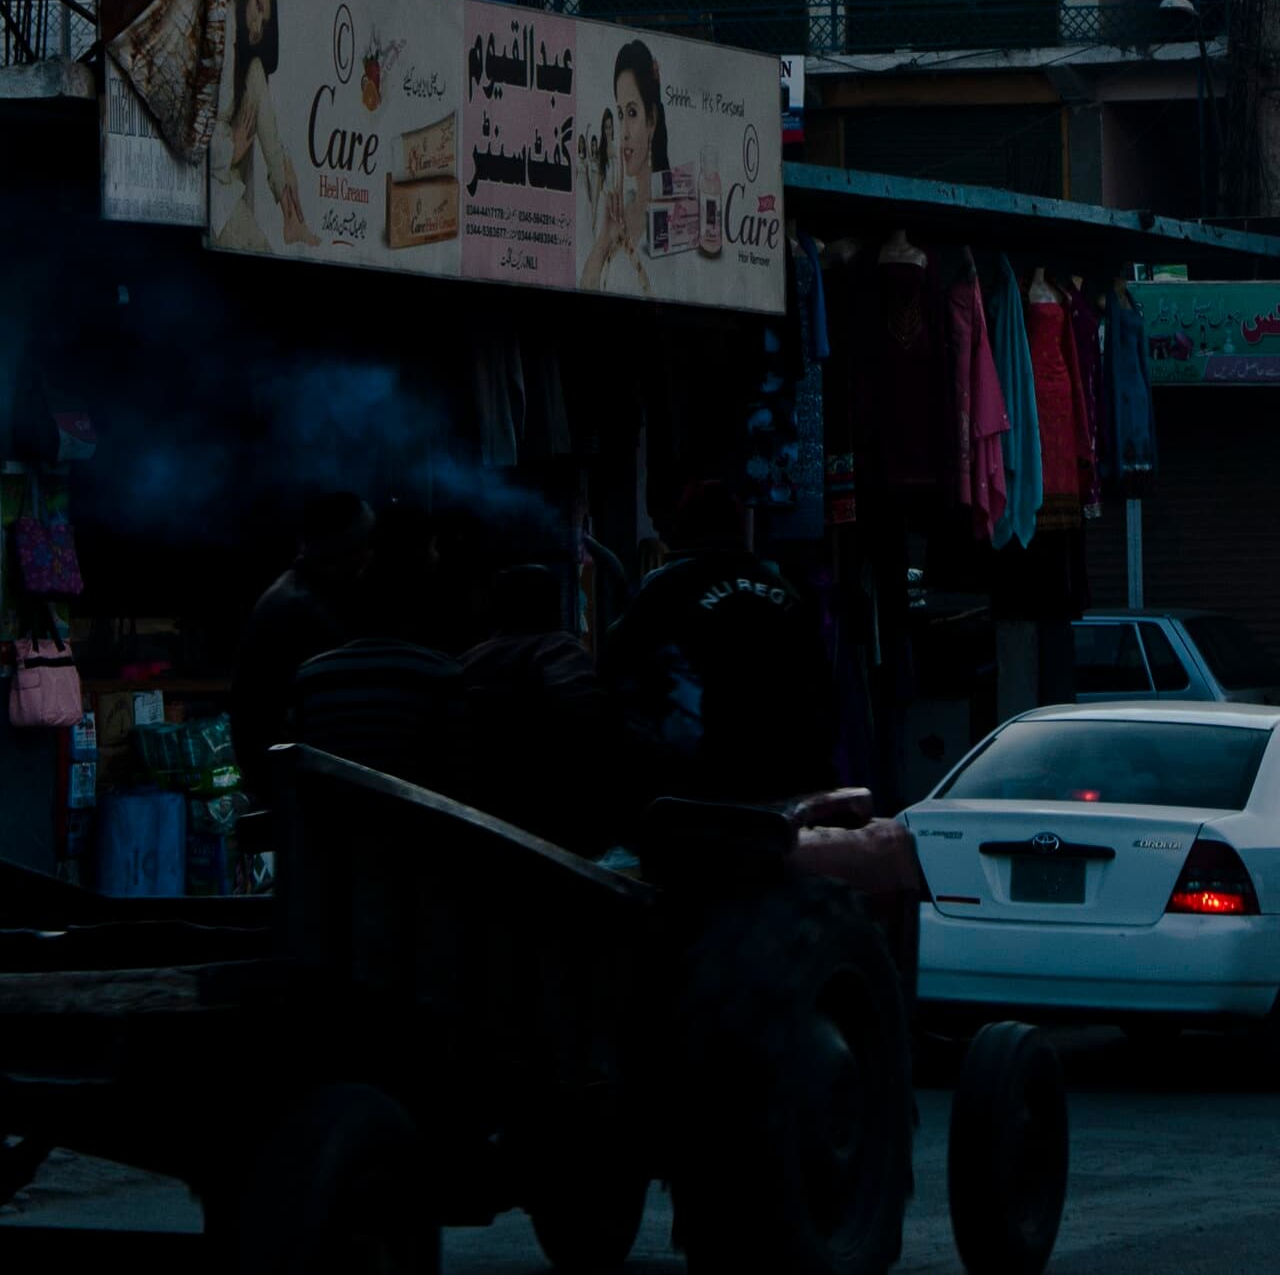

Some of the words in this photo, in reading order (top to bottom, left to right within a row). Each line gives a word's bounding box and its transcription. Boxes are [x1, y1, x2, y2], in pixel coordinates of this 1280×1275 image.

[308, 85, 379, 175] Care
[466, 108, 526, 197] سنٹر
[527, 116, 573, 192] گفٹ
[320, 175, 340, 201] Heel
[341, 179, 369, 204] Cream
[725, 182, 780, 250] Care
